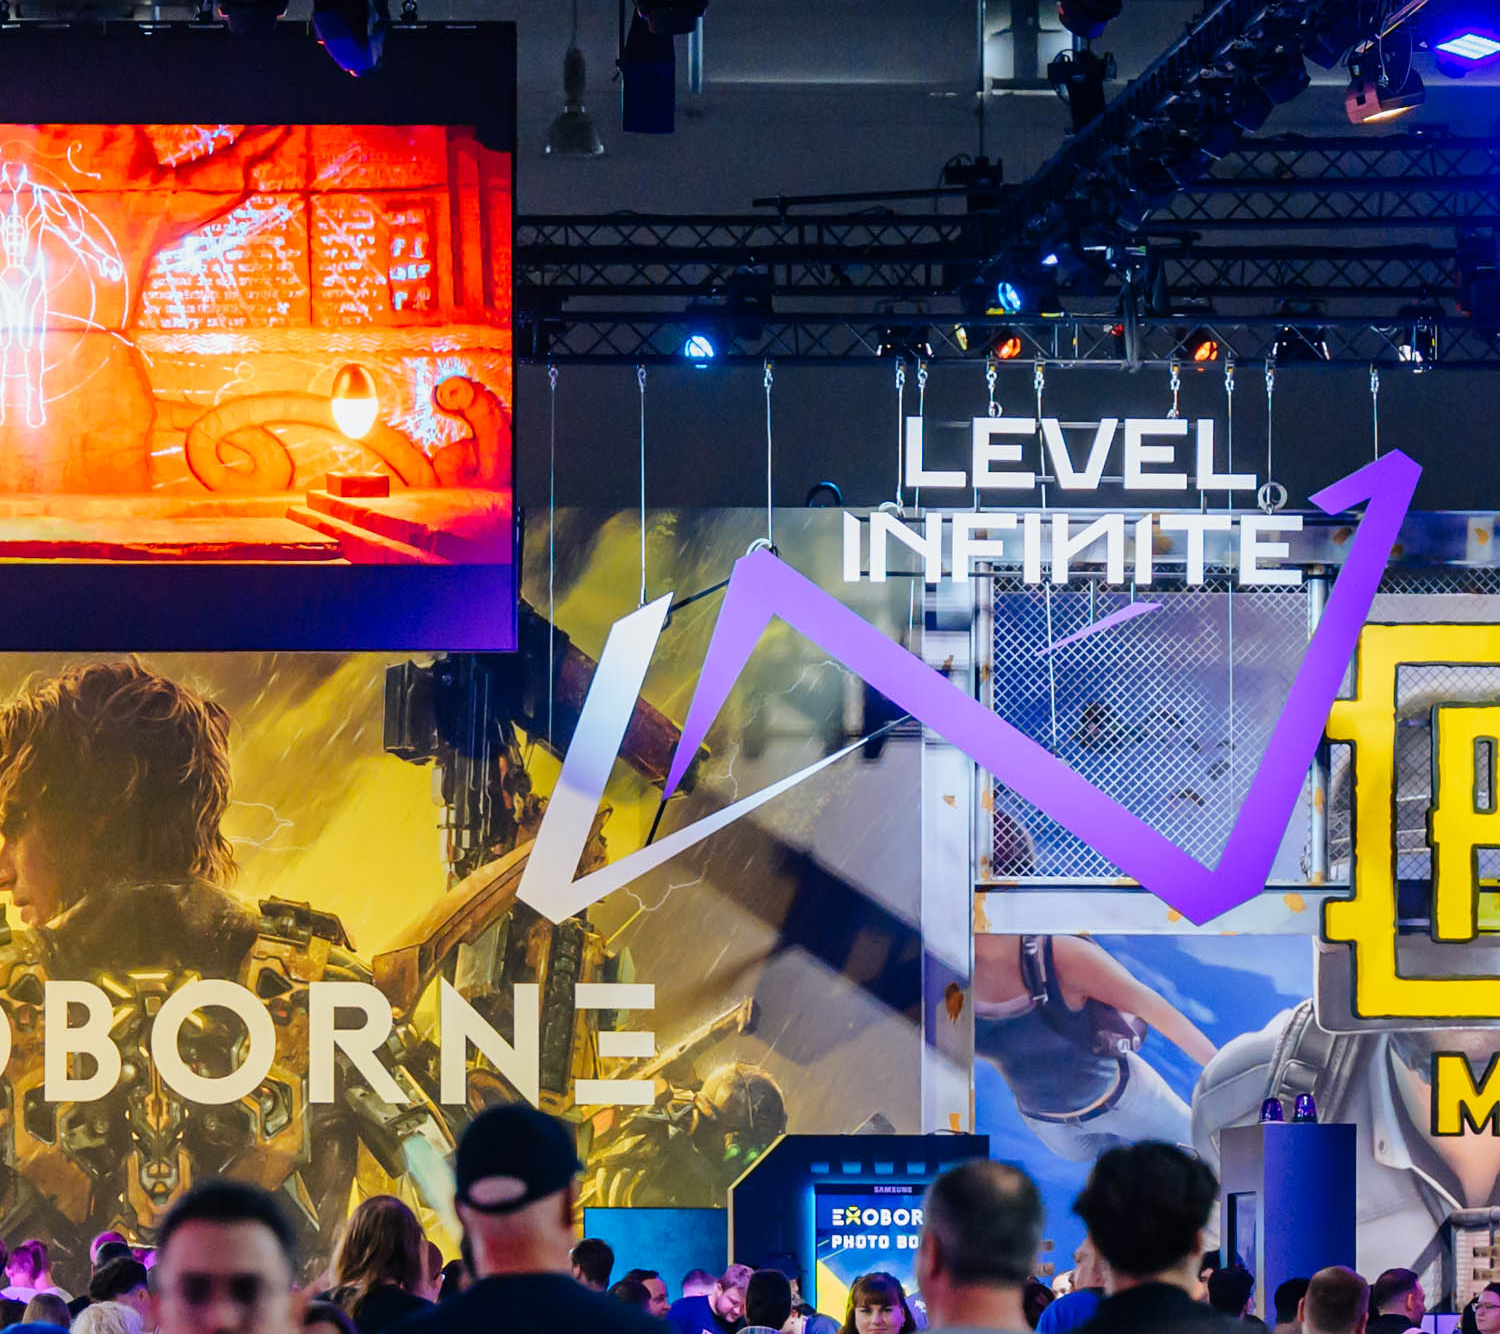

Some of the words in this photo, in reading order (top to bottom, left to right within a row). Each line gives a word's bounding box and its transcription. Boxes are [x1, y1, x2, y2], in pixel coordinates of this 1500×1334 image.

[905, 417, 1257, 492] LEVEL
[843, 511, 1304, 586] INFINITE
[874, 1185, 913, 1194] SAMSUNG
[831, 1206, 924, 1227] EXOBOR
[831, 1234, 890, 1250] PHOTO
